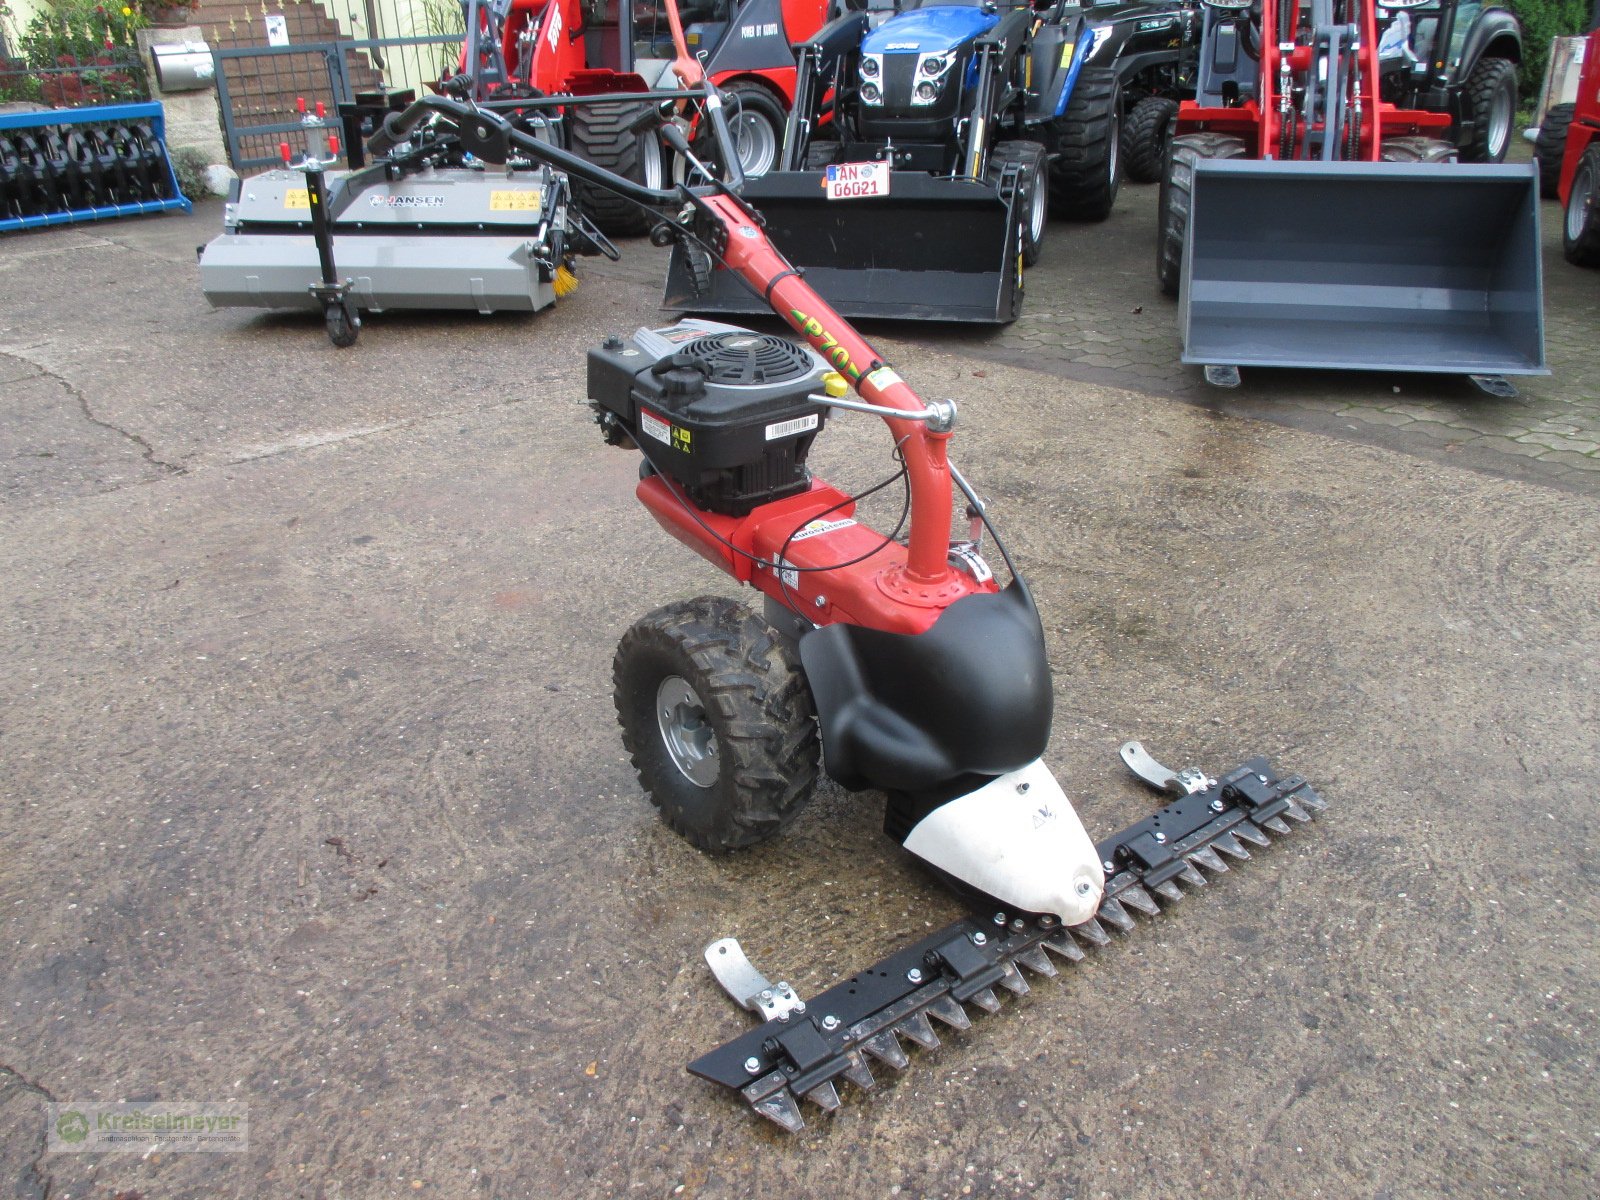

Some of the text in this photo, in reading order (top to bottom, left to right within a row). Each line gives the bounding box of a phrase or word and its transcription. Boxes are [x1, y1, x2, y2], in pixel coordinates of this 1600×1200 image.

[741, 25, 755, 39] POWER
[756, 25, 762, 37] BY
[840, 166, 858, 180] AN
[834, 180, 879, 197] 06021
[387, 196, 444, 204] JANSEN
[804, 316, 850, 370] P70
[793, 520, 854, 539] eurosystems
